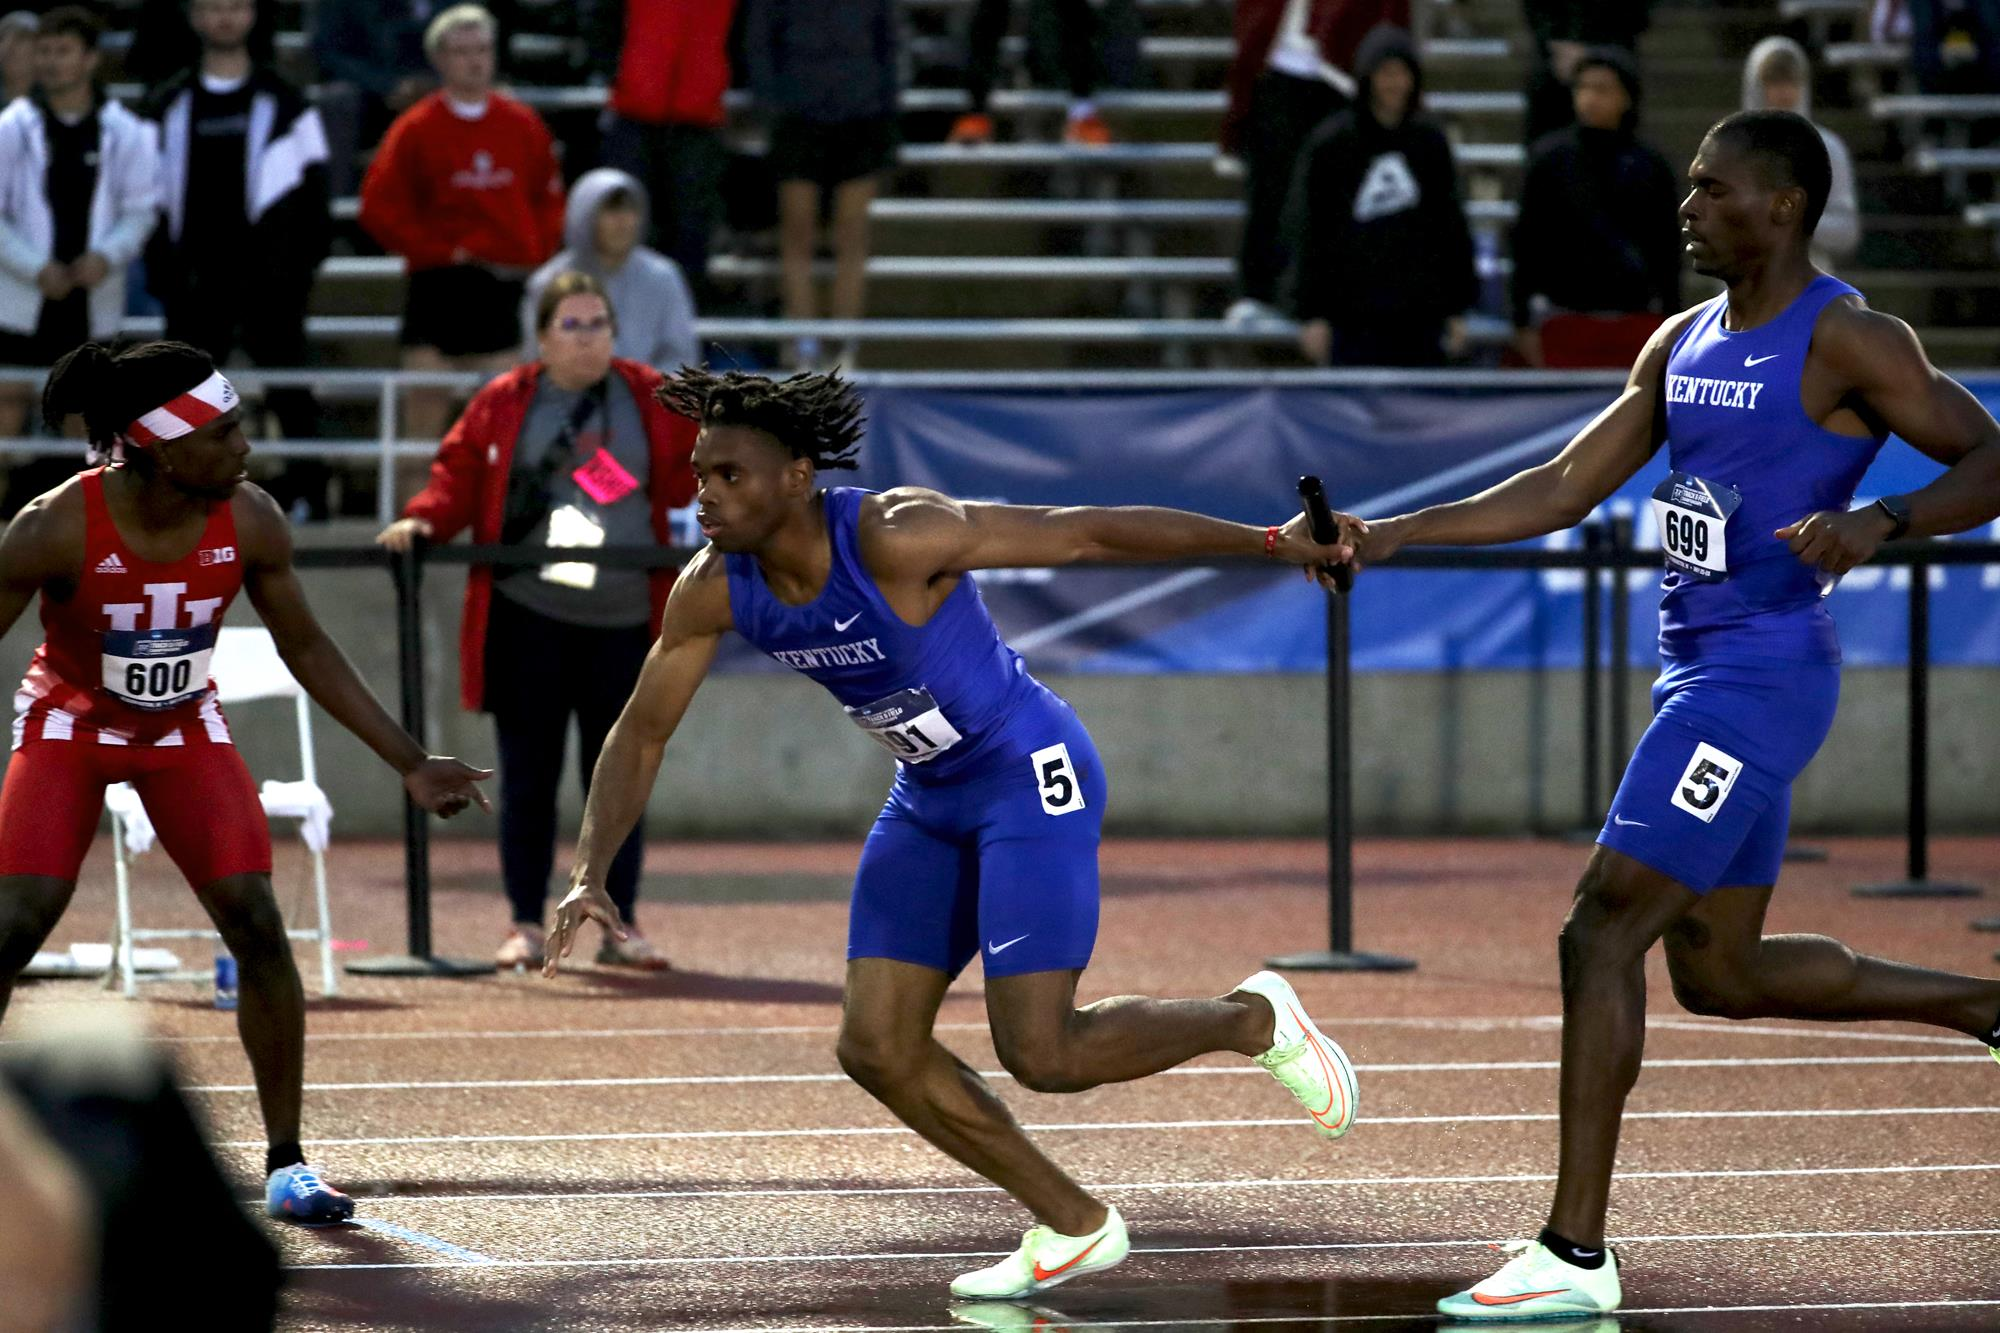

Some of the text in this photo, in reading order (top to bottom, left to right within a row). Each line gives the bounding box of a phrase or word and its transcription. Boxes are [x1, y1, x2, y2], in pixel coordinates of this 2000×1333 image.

[1665, 374, 1764, 410] KENTUCKY
[1666, 510, 1709, 562] 699
[772, 638, 886, 669] KENTUCKY
[126, 659, 191, 697] 600
[1042, 757, 1073, 807] 5
[1682, 758, 1730, 810] 5
